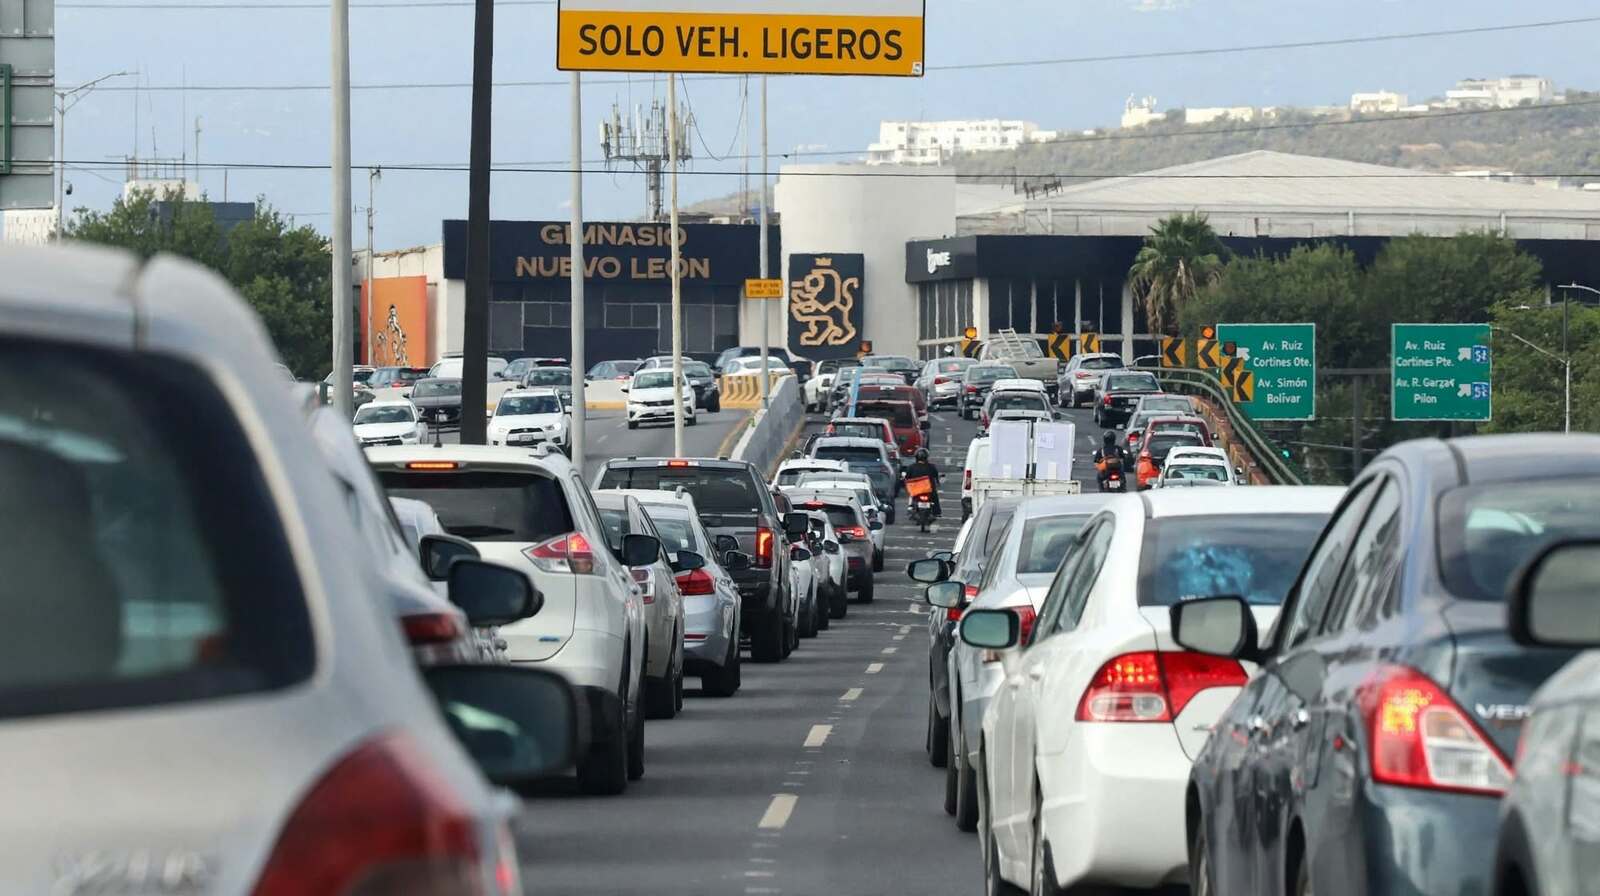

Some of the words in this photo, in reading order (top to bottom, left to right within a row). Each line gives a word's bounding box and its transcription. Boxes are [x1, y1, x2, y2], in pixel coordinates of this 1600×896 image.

[579, 24, 664, 57] SOLO
[676, 25, 749, 58] VEH.
[763, 27, 903, 61] LIGEROS
[540, 224, 688, 247] GIMNASIO
[515, 255, 622, 279] NUEVO
[1262, 341, 1278, 351] Av.
[1405, 341, 1420, 351] Av.
[1423, 340, 1446, 351] Ruiz
[1253, 357, 1292, 367] Cortines
[1293, 357, 1312, 367] Ote.
[1395, 356, 1434, 367] Cortines
[1435, 356, 1455, 367] Pte.
[1257, 378, 1274, 388] Av.
[1276, 376, 1308, 388] Simón
[1395, 378, 1410, 388] Av.
